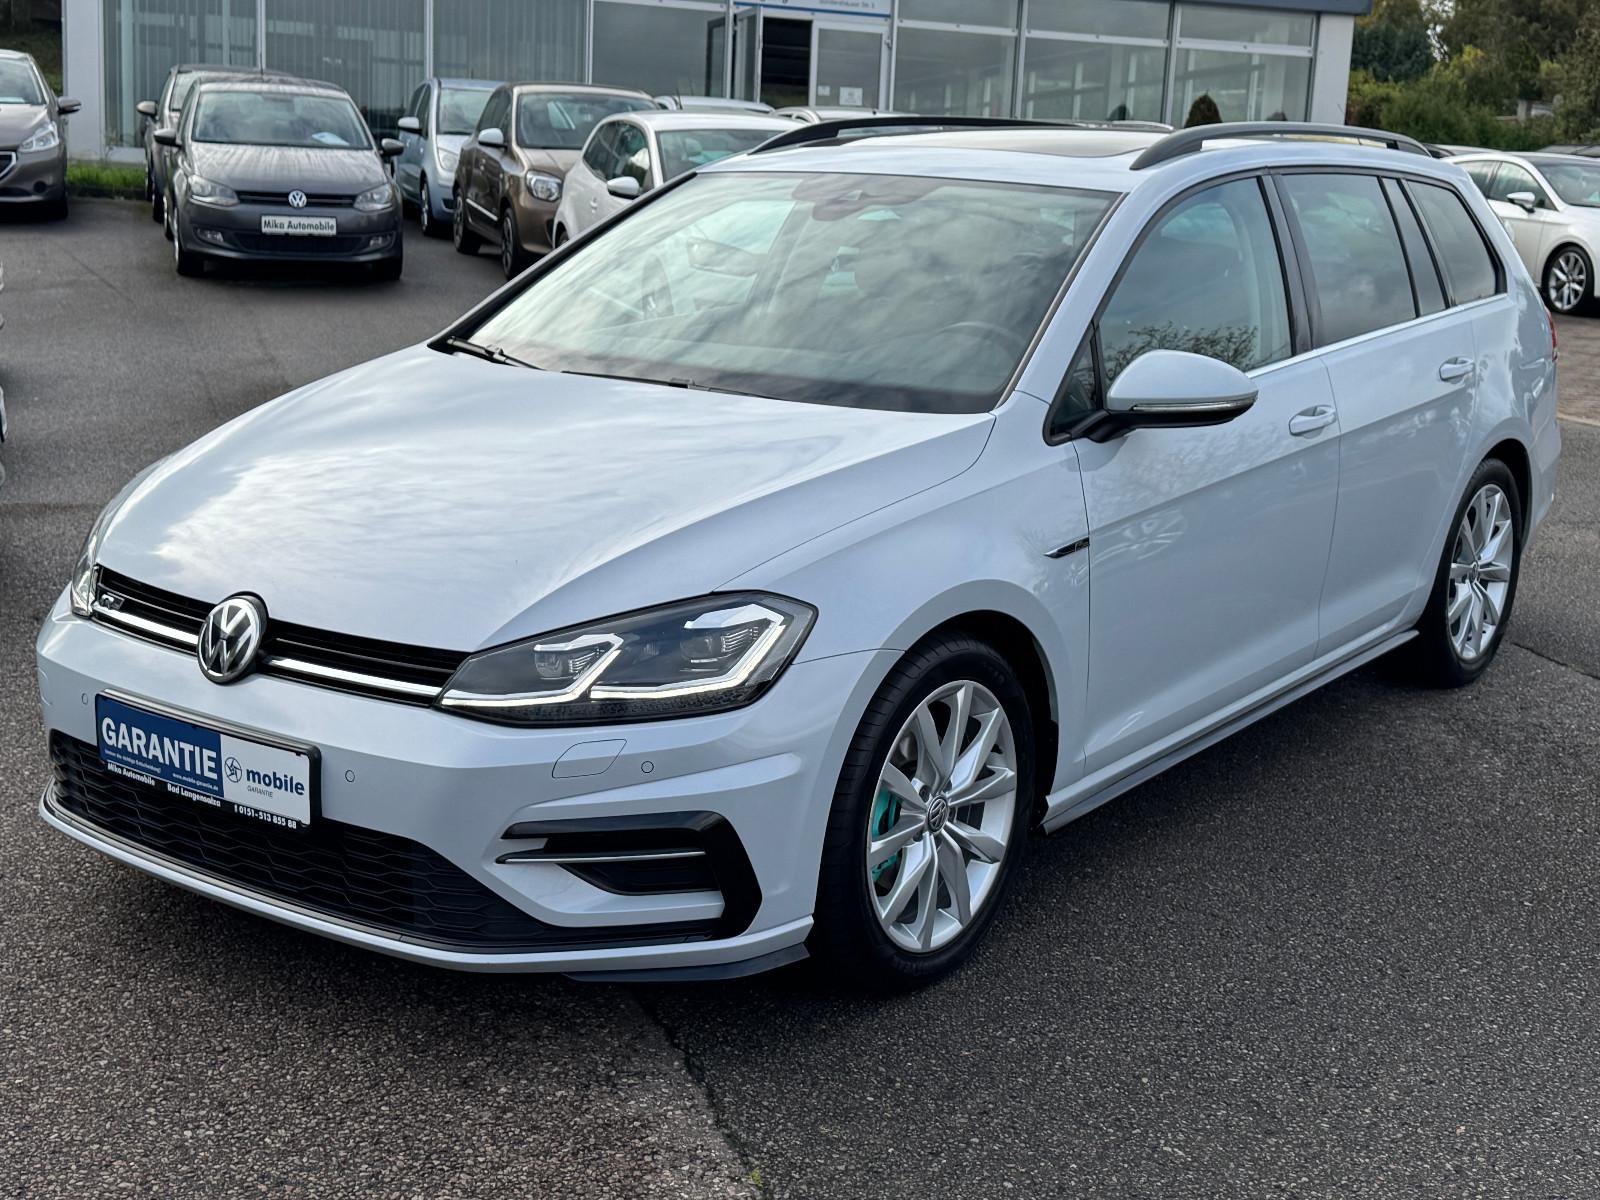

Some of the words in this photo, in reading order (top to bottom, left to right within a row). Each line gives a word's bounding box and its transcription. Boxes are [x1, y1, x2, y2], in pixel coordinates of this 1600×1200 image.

[263, 219, 285, 231] Mika
[287, 220, 335, 232] Automobile
[199, 597, 261, 678] VW
[102, 717, 218, 780] GARANTIE
[107, 762, 122, 774] Mika
[122, 768, 156, 786] Automobile
[246, 769, 305, 796] mobile
[167, 782, 180, 794] Bad
[247, 785, 274, 798] GARANTIE
[272, 815, 286, 826] 855
